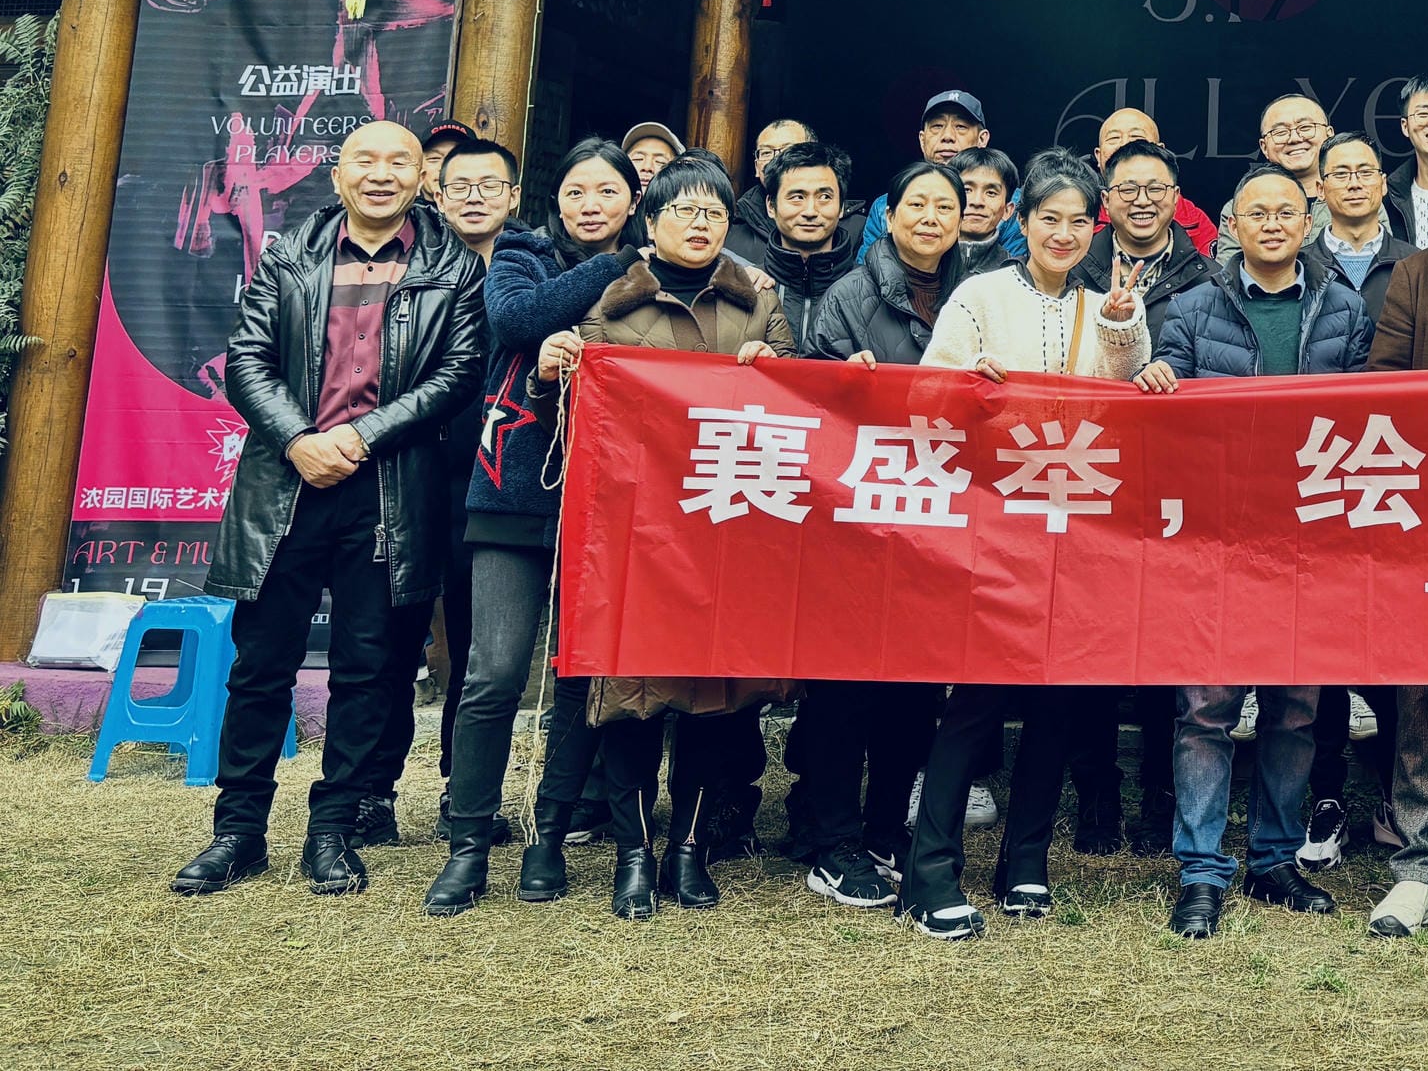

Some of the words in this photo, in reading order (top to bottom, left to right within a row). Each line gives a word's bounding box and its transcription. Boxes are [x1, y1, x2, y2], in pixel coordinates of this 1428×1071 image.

[238, 64, 362, 97] 公益演出
[234, 144, 341, 164] PLAYERS
[72, 540, 145, 565] ART
[150, 540, 168, 565] &
